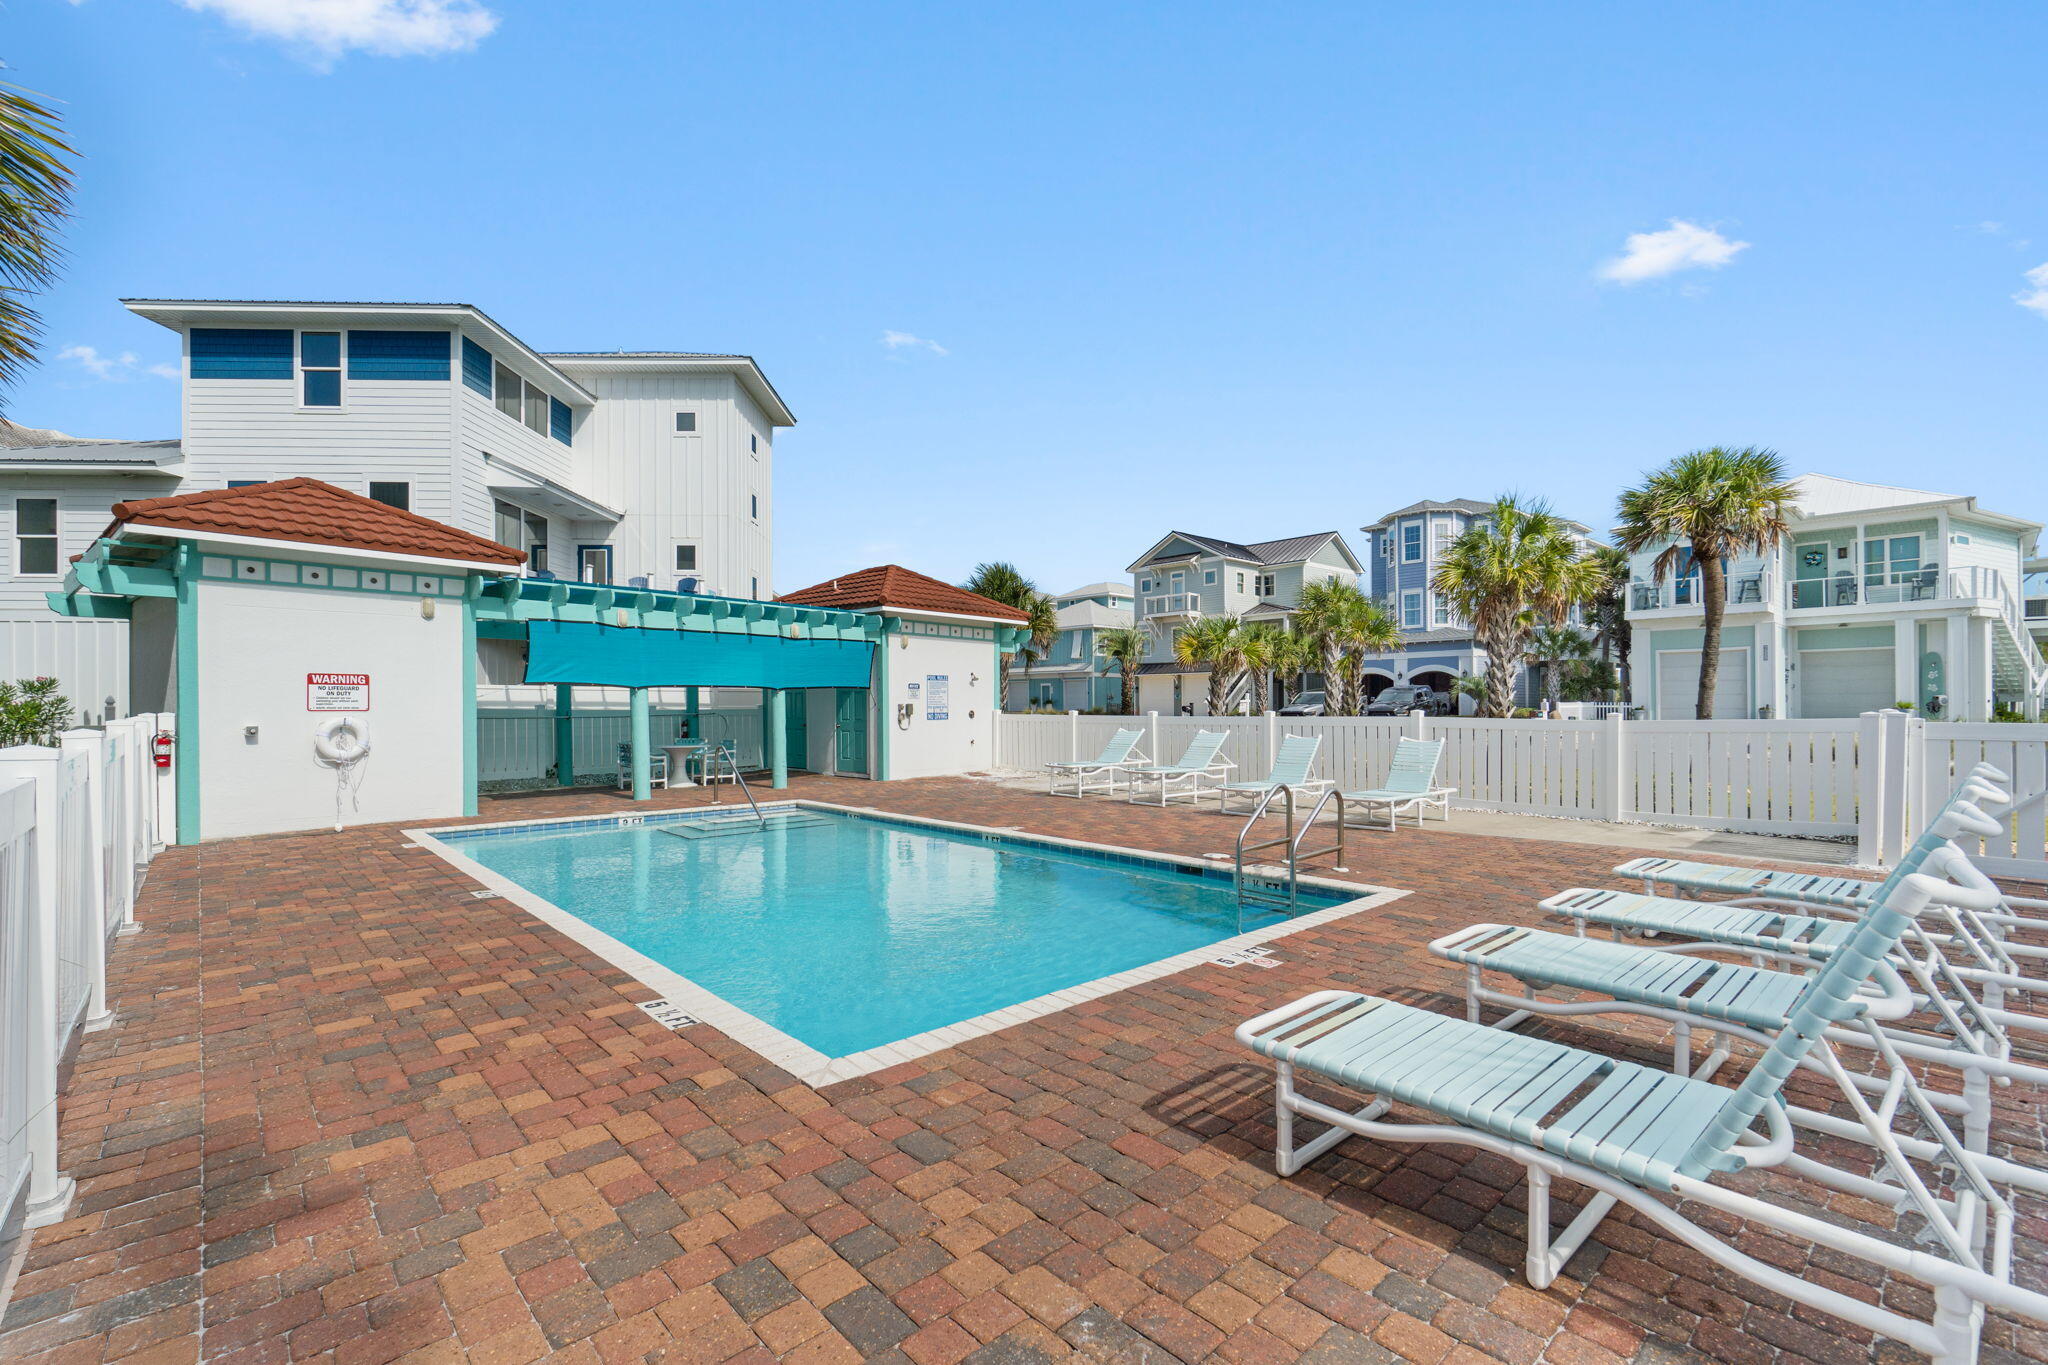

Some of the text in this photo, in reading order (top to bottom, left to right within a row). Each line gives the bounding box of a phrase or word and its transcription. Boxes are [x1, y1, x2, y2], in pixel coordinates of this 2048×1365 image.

[311, 674, 366, 684] WARNING
[1216, 957, 1236, 965] 5
[1243, 946, 1271, 955] FT
[644, 1001, 669, 1009] 5
[664, 1015, 698, 1028] FT
